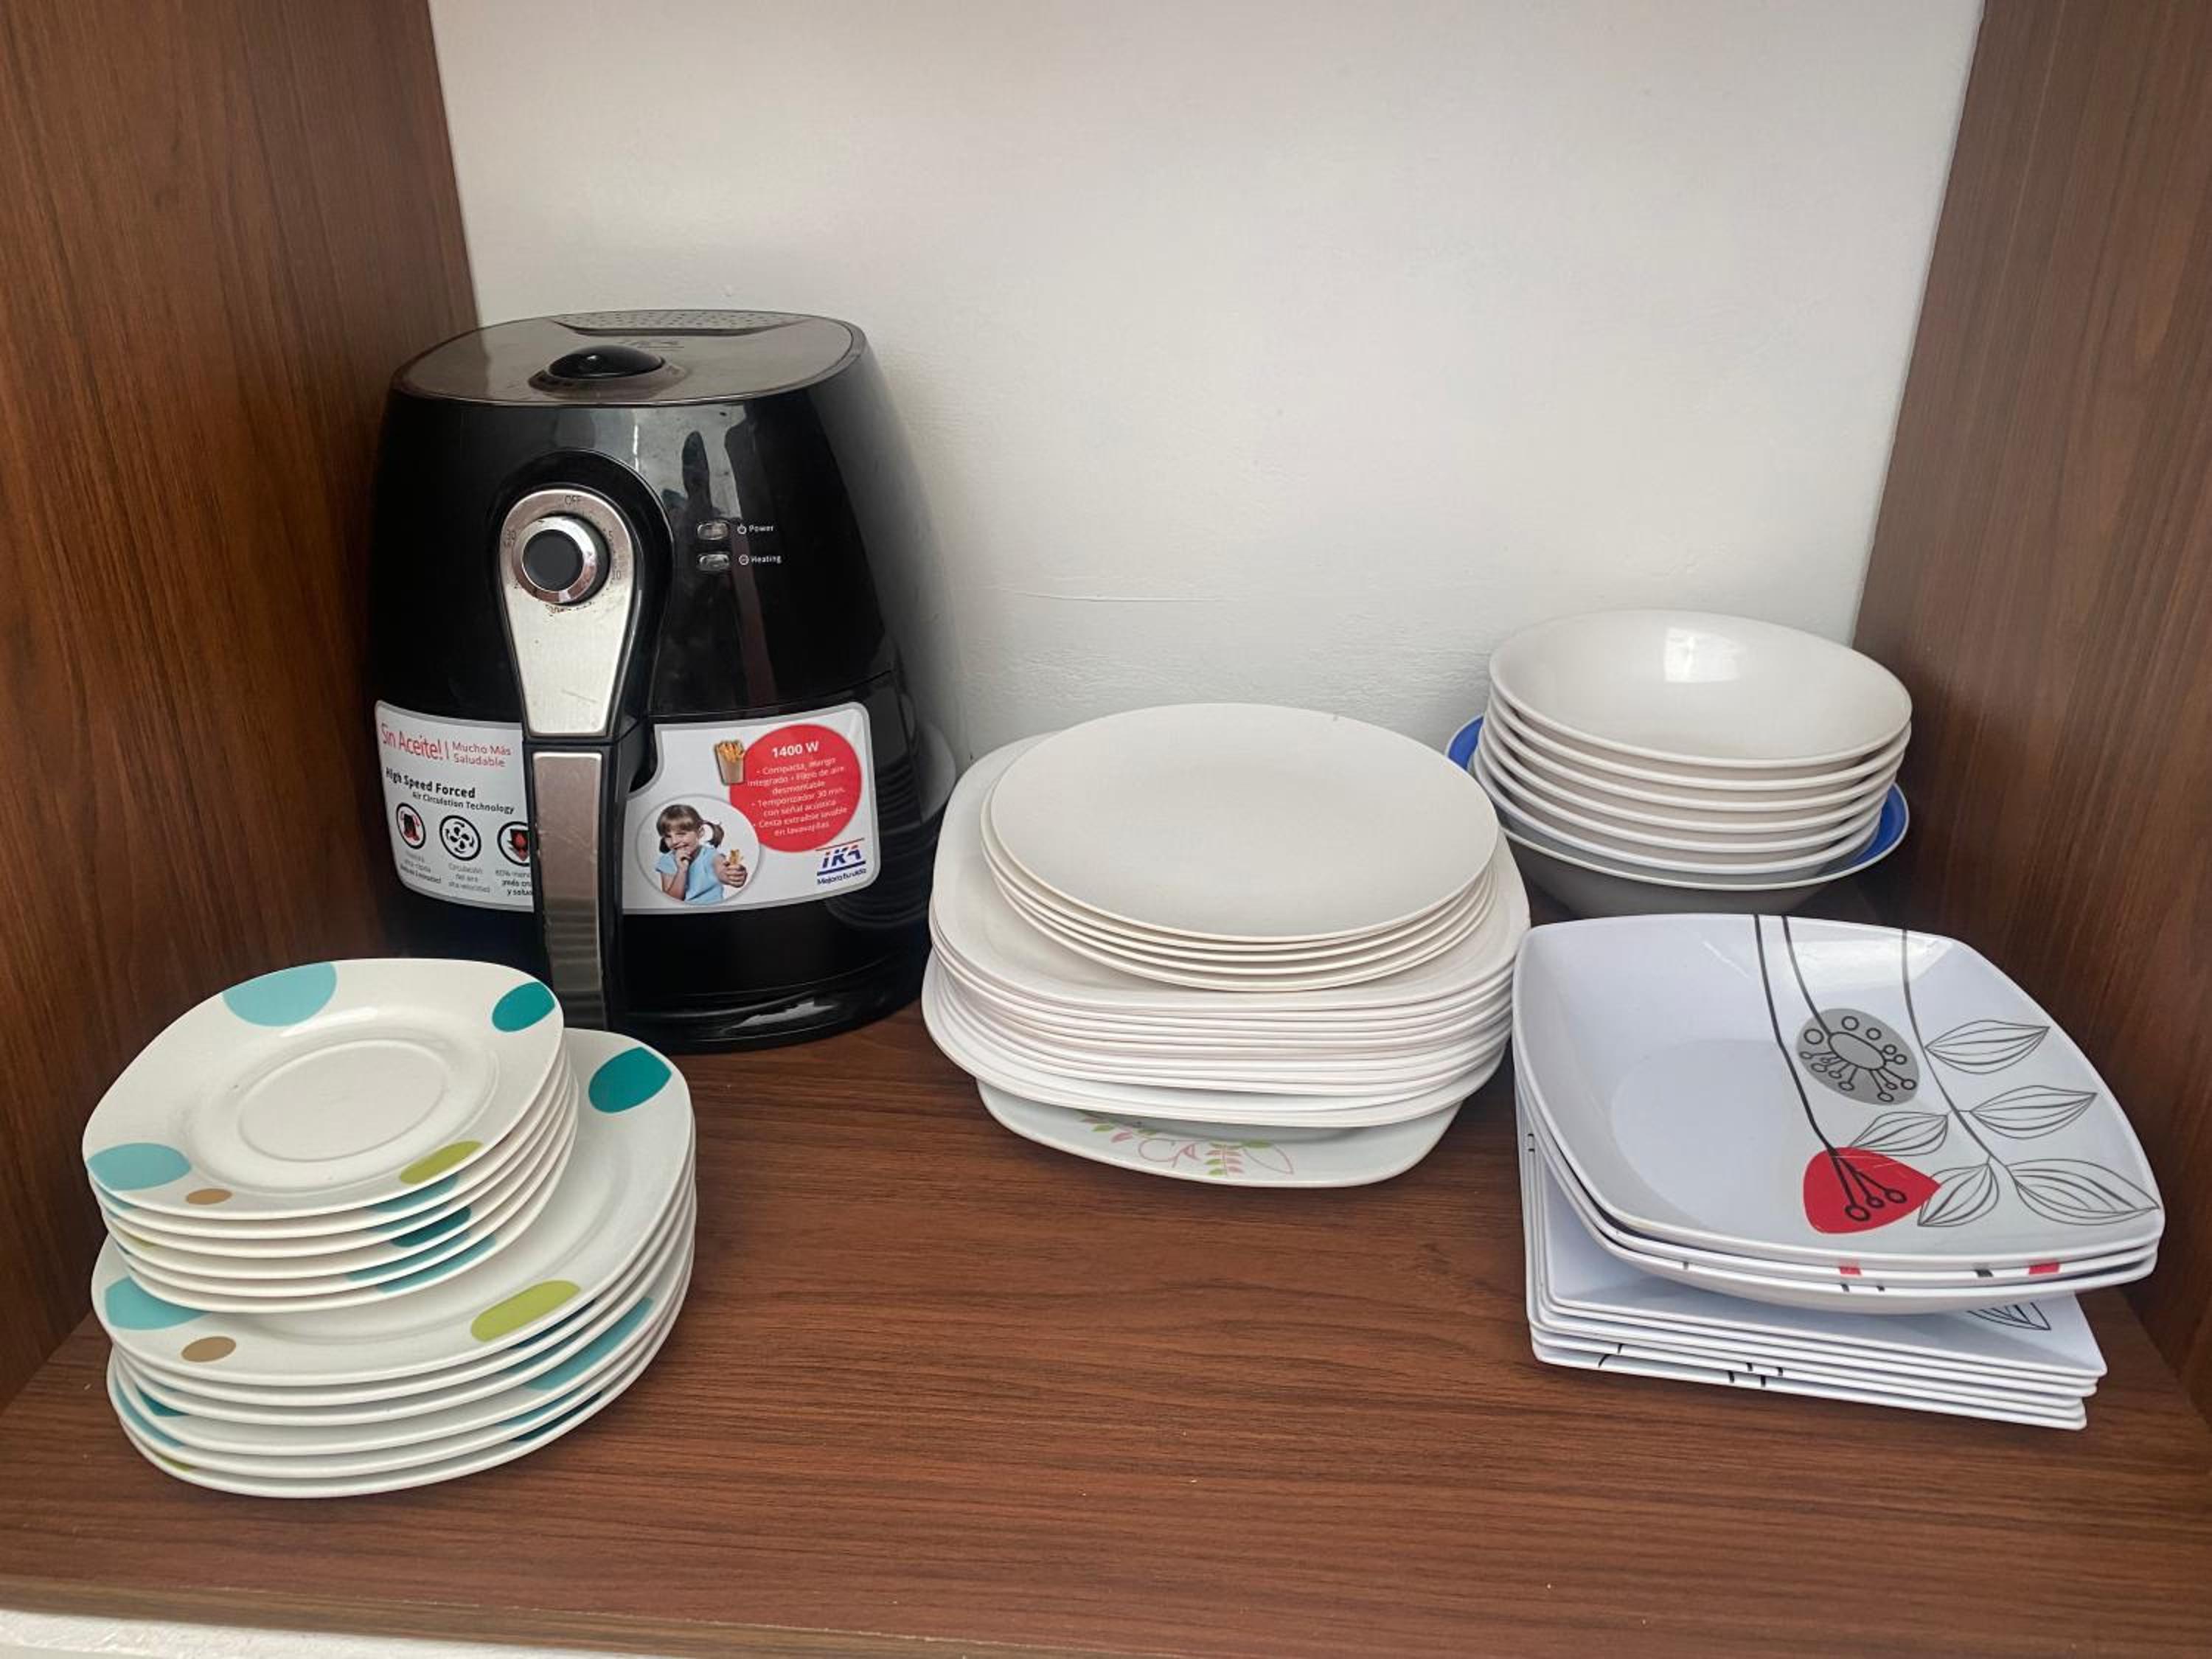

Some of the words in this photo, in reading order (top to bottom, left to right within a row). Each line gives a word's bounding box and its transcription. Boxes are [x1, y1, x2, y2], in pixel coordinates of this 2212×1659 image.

[564, 495, 582, 506] OFF
[748, 524, 773, 532] Power
[607, 530, 614, 542] 5
[751, 555, 782, 564] Heating
[612, 571, 622, 580] 10
[380, 722, 396, 748] Sin
[399, 731, 443, 761] Aceite!
[452, 741, 488, 754] Mucho
[490, 745, 512, 756] Más
[772, 744, 803, 758] 1400
[805, 740, 819, 752] W
[453, 753, 506, 768] Saludable
[386, 767, 402, 784] High
[403, 774, 433, 791] Speed
[435, 782, 476, 799] Forced
[422, 793, 464, 809] Circulation
[466, 801, 515, 815] Technology
